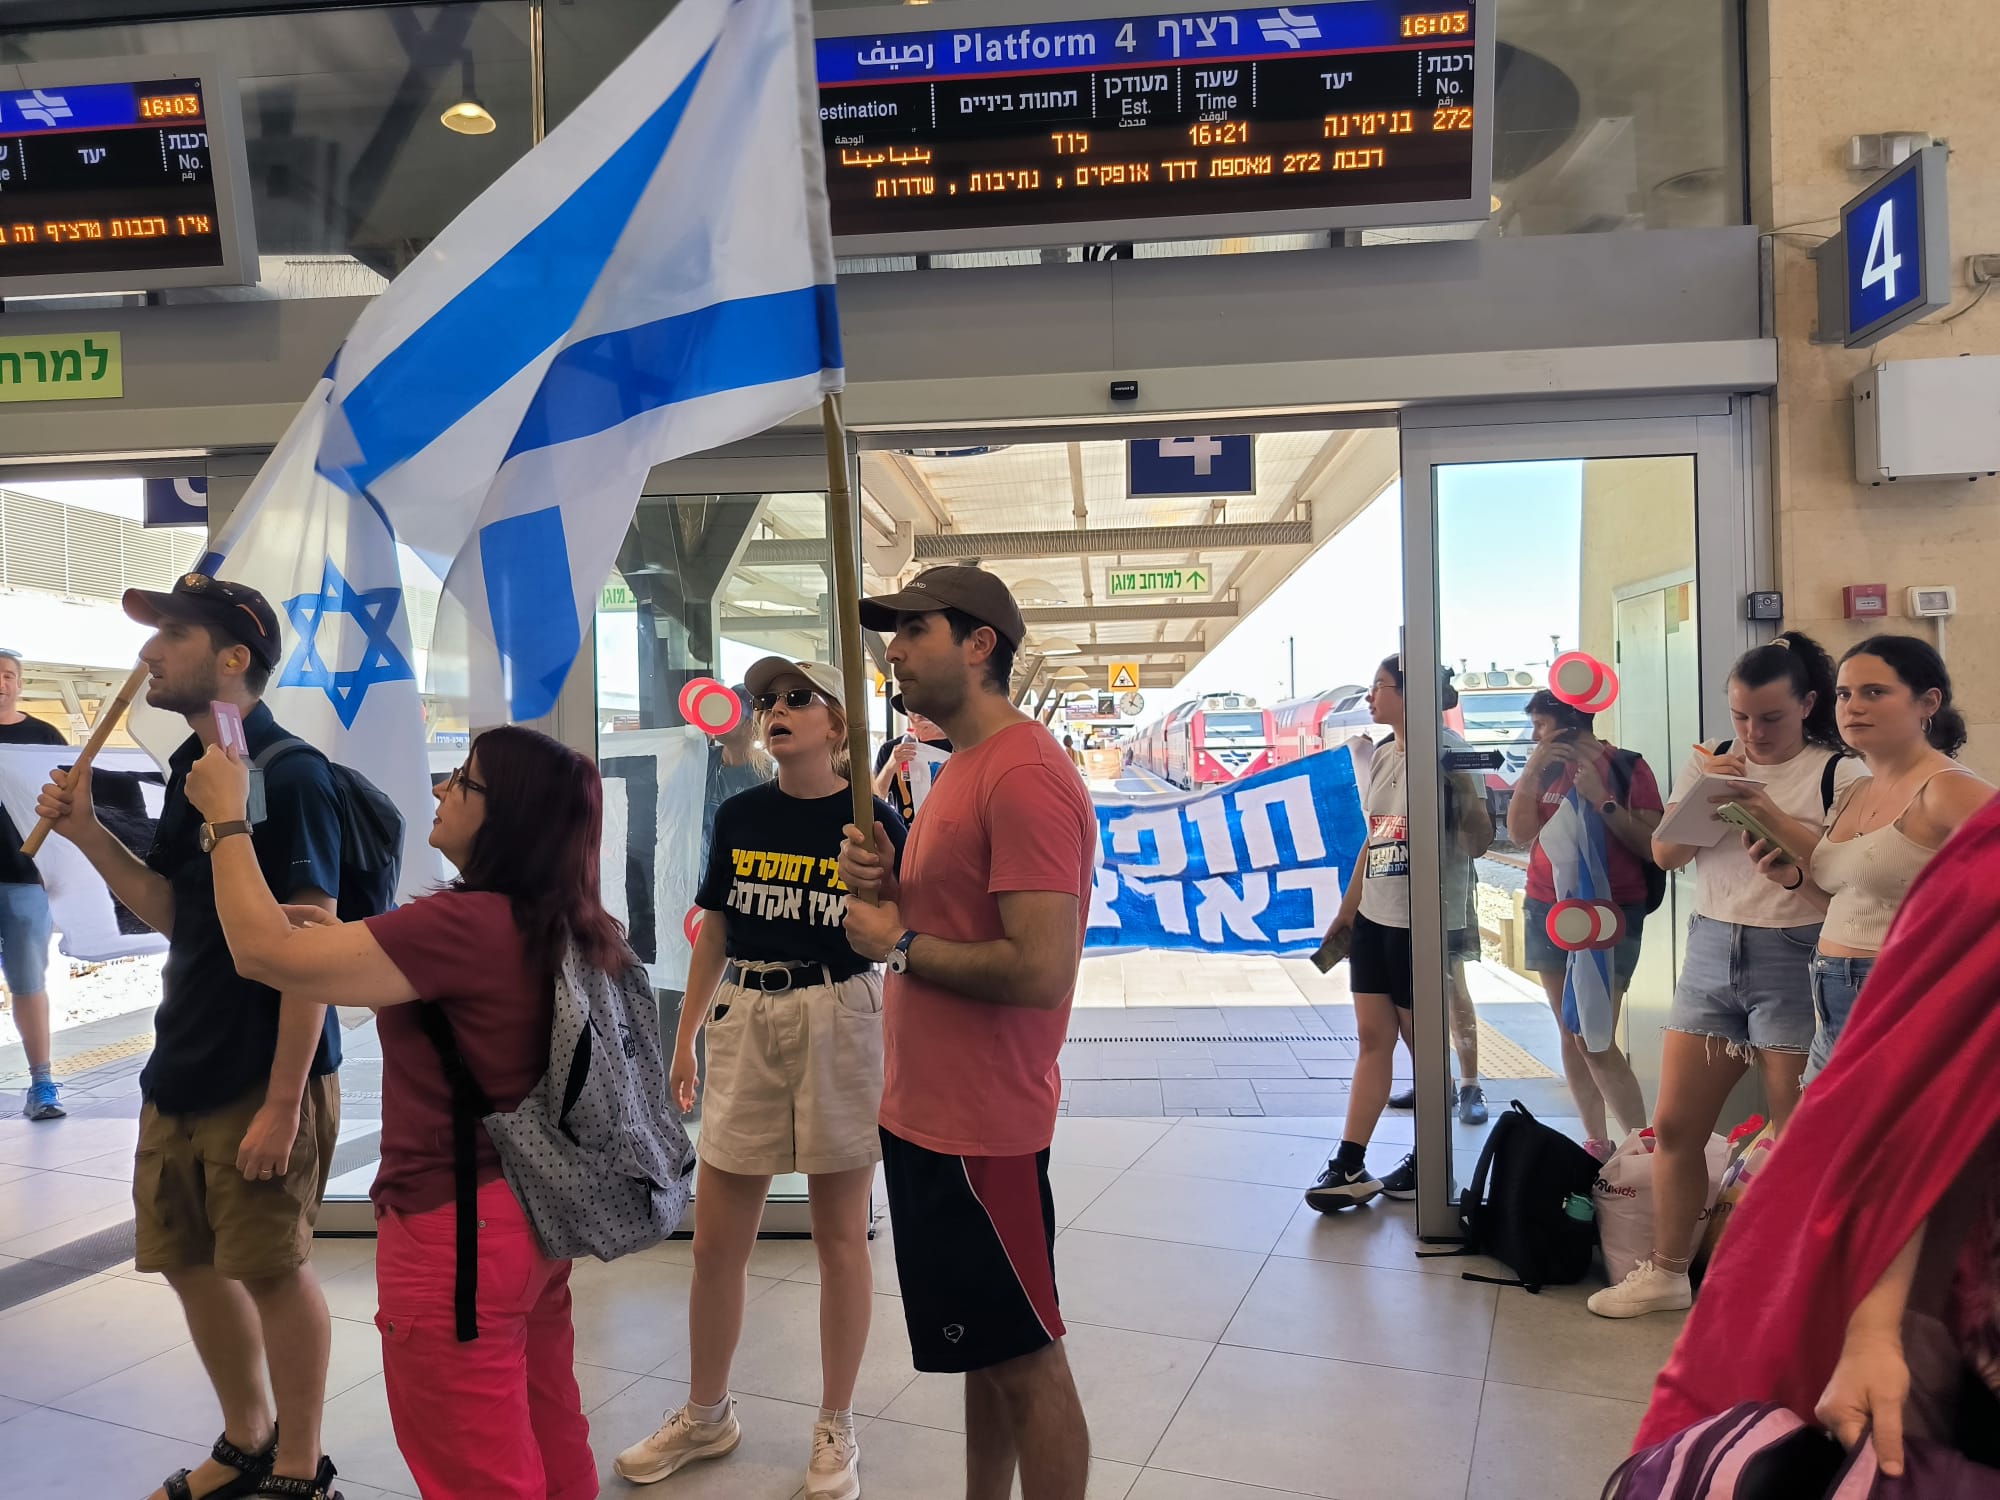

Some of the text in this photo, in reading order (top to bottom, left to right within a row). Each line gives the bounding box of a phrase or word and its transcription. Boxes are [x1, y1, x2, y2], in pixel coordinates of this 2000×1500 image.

[1404, 13, 1467, 36] 16:03
[953, 23, 1137, 64] Platform 4
[1158, 15, 1238, 58] רציף
[857, 41, 935, 70] رصيف
[1427, 53, 1473, 73] רכבת
[1103, 73, 1168, 98] מעודכן
[1195, 69, 1239, 89] שעה
[1320, 72, 1353, 91] יעד
[1436, 78, 1464, 95] No.
[143, 97, 198, 118] 16:03
[819, 100, 898, 120] estination
[959, 89, 1078, 114] תחנות ביניים
[1121, 98, 1151, 116] Est.
[1196, 93, 1237, 111] Time
[1199, 110, 1228, 123] الوقت
[1433, 109, 1473, 131] 272
[168, 132, 209, 150] רכבת
[1051, 132, 1088, 154] לוד
[1189, 122, 1248, 146] 16:21
[78, 147, 107, 165] יעד
[178, 154, 204, 170] No.
[1209, 155, 1272, 178] מאספת
[1283, 152, 1321, 174] 272
[1332, 148, 1384, 171] רכבת
[1160, 159, 1198, 182] דרך
[876, 175, 935, 199] שדרות
[14, 225, 35, 243] זה
[46, 222, 101, 242] מרציף
[111, 217, 166, 237] רכבות
[178, 216, 209, 236] אין
[1861, 198, 1902, 301] 4
[0, 339, 109, 385] למרח
[1110, 569, 1182, 595] למרחב מוגן
[1096, 775, 1327, 878] חופ
[808, 889, 848, 927] אין
